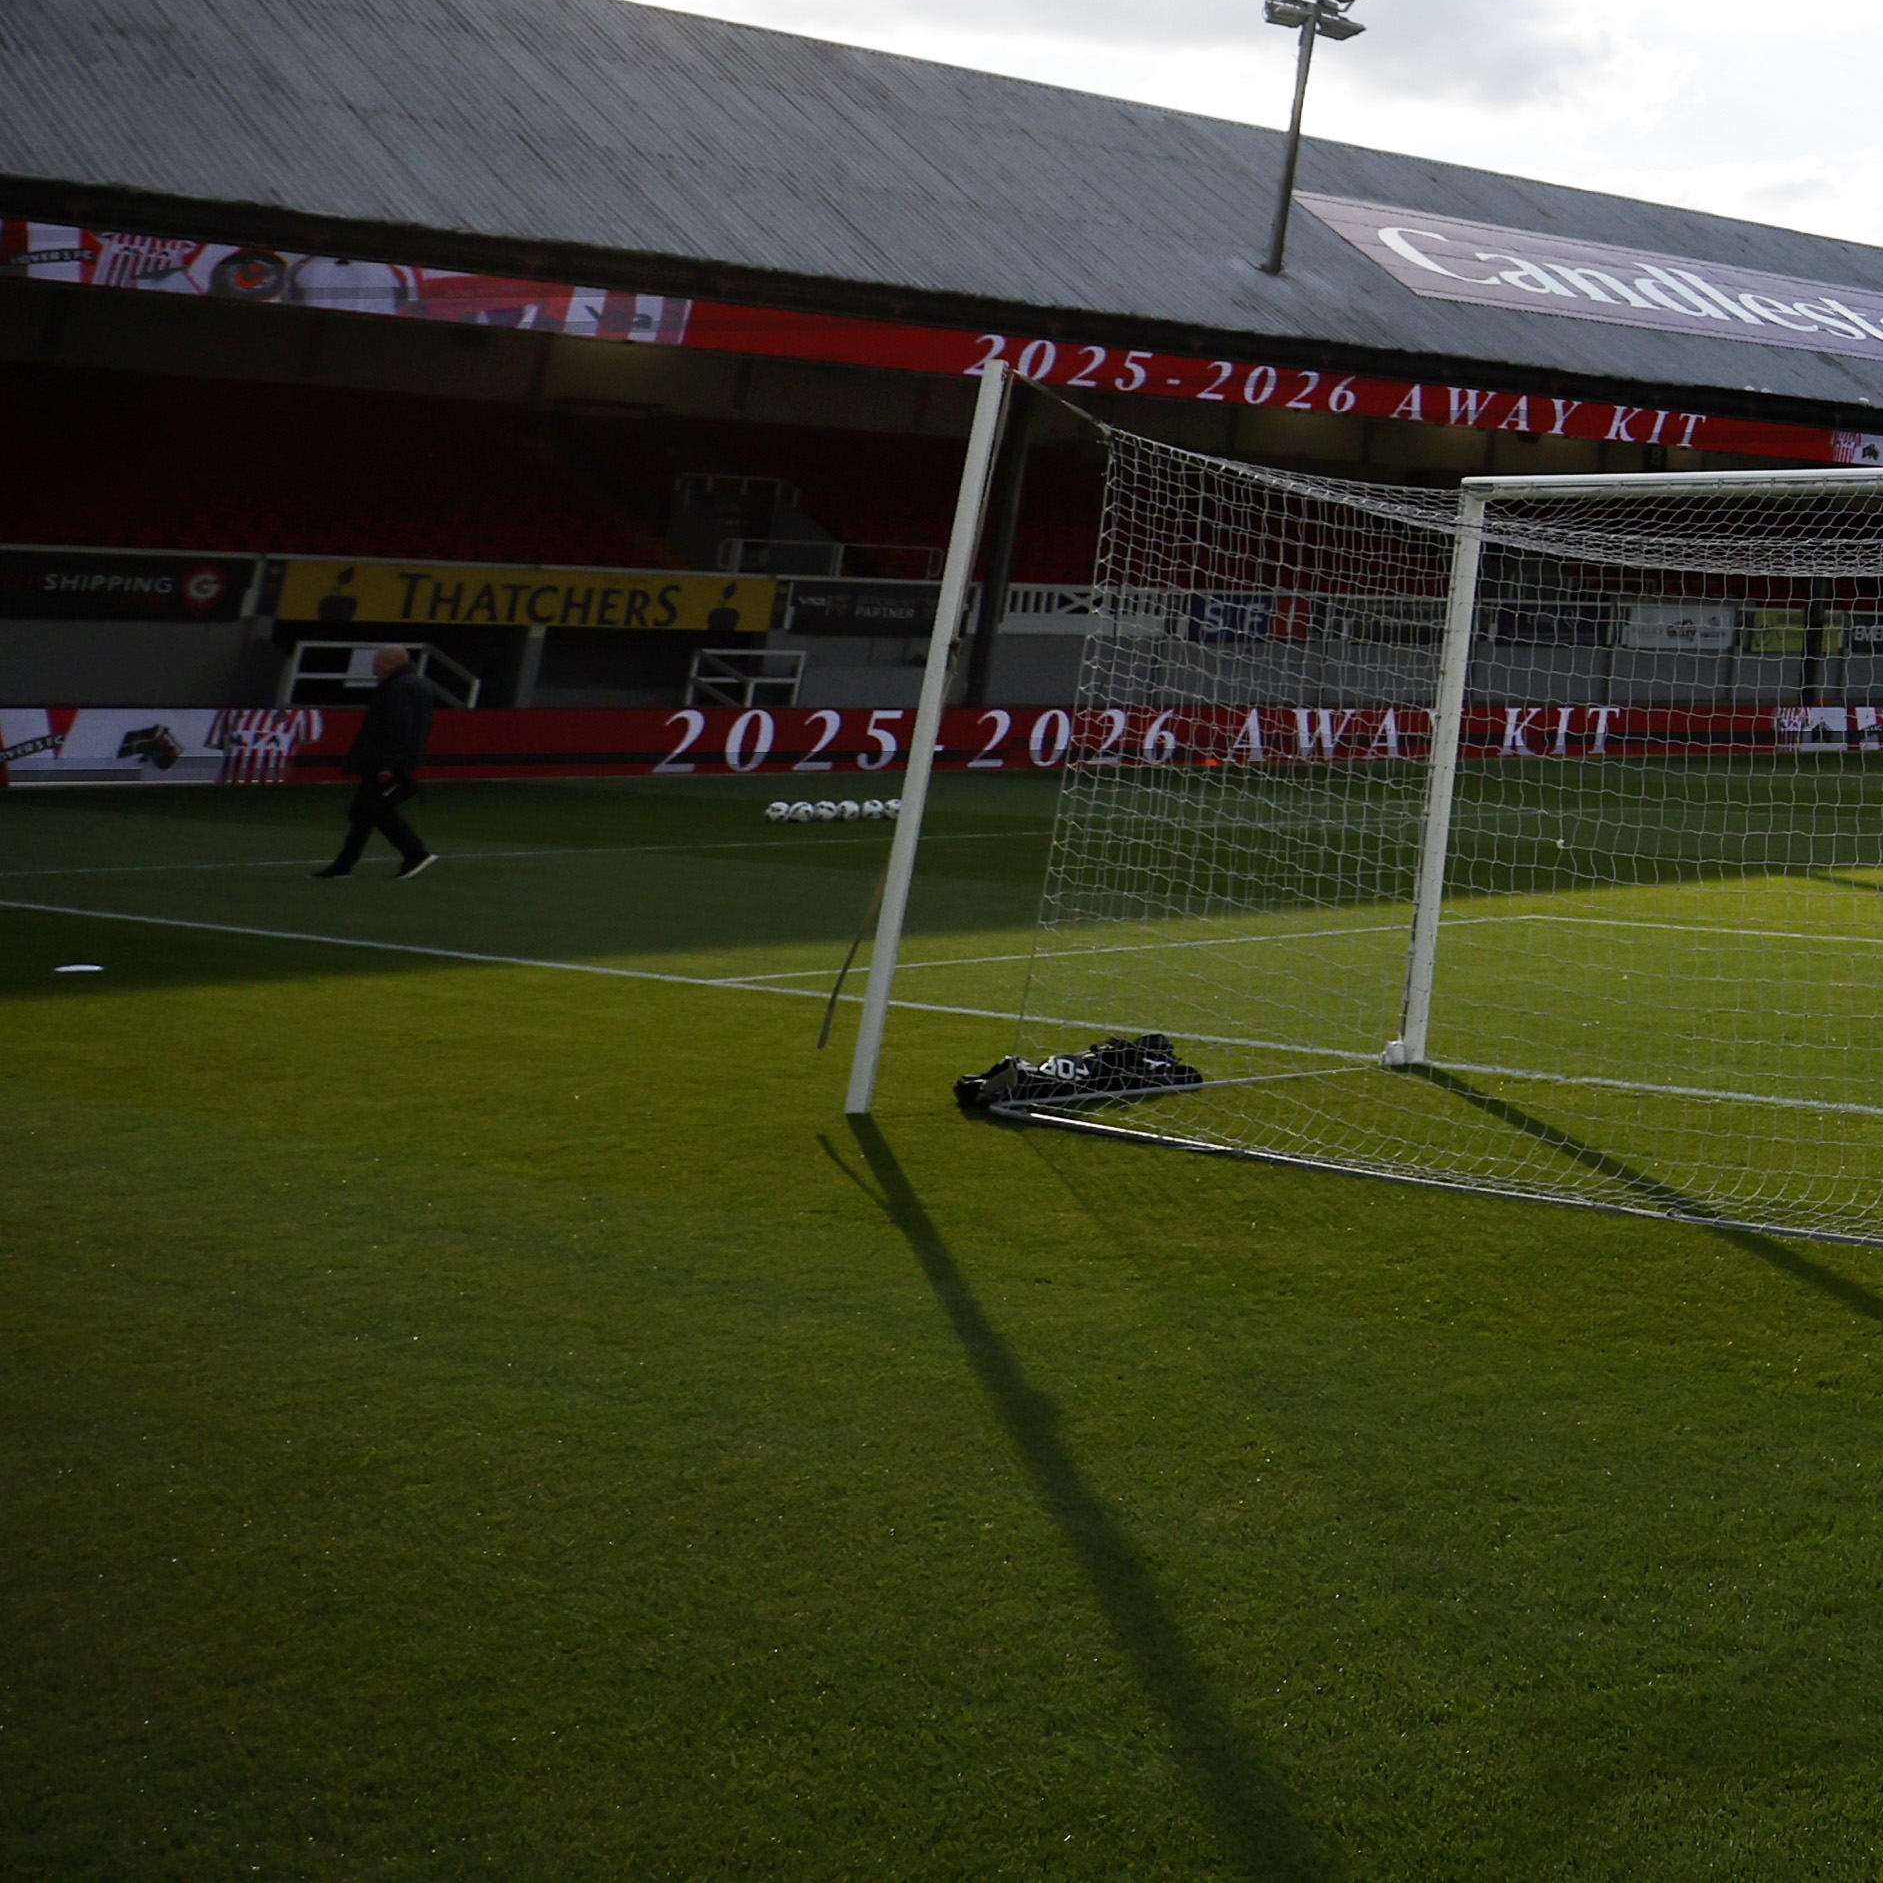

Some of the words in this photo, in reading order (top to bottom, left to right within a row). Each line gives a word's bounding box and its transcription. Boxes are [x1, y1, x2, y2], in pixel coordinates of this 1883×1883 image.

[1389, 382, 1584, 435] AWAY
[1603, 405, 1707, 448] KIT
[44, 573, 173, 595] SHIPPING
[398, 572, 682, 628] THATCHERS
[855, 605, 916, 620] PARTNER
[1497, 706, 1621, 757] KIT
